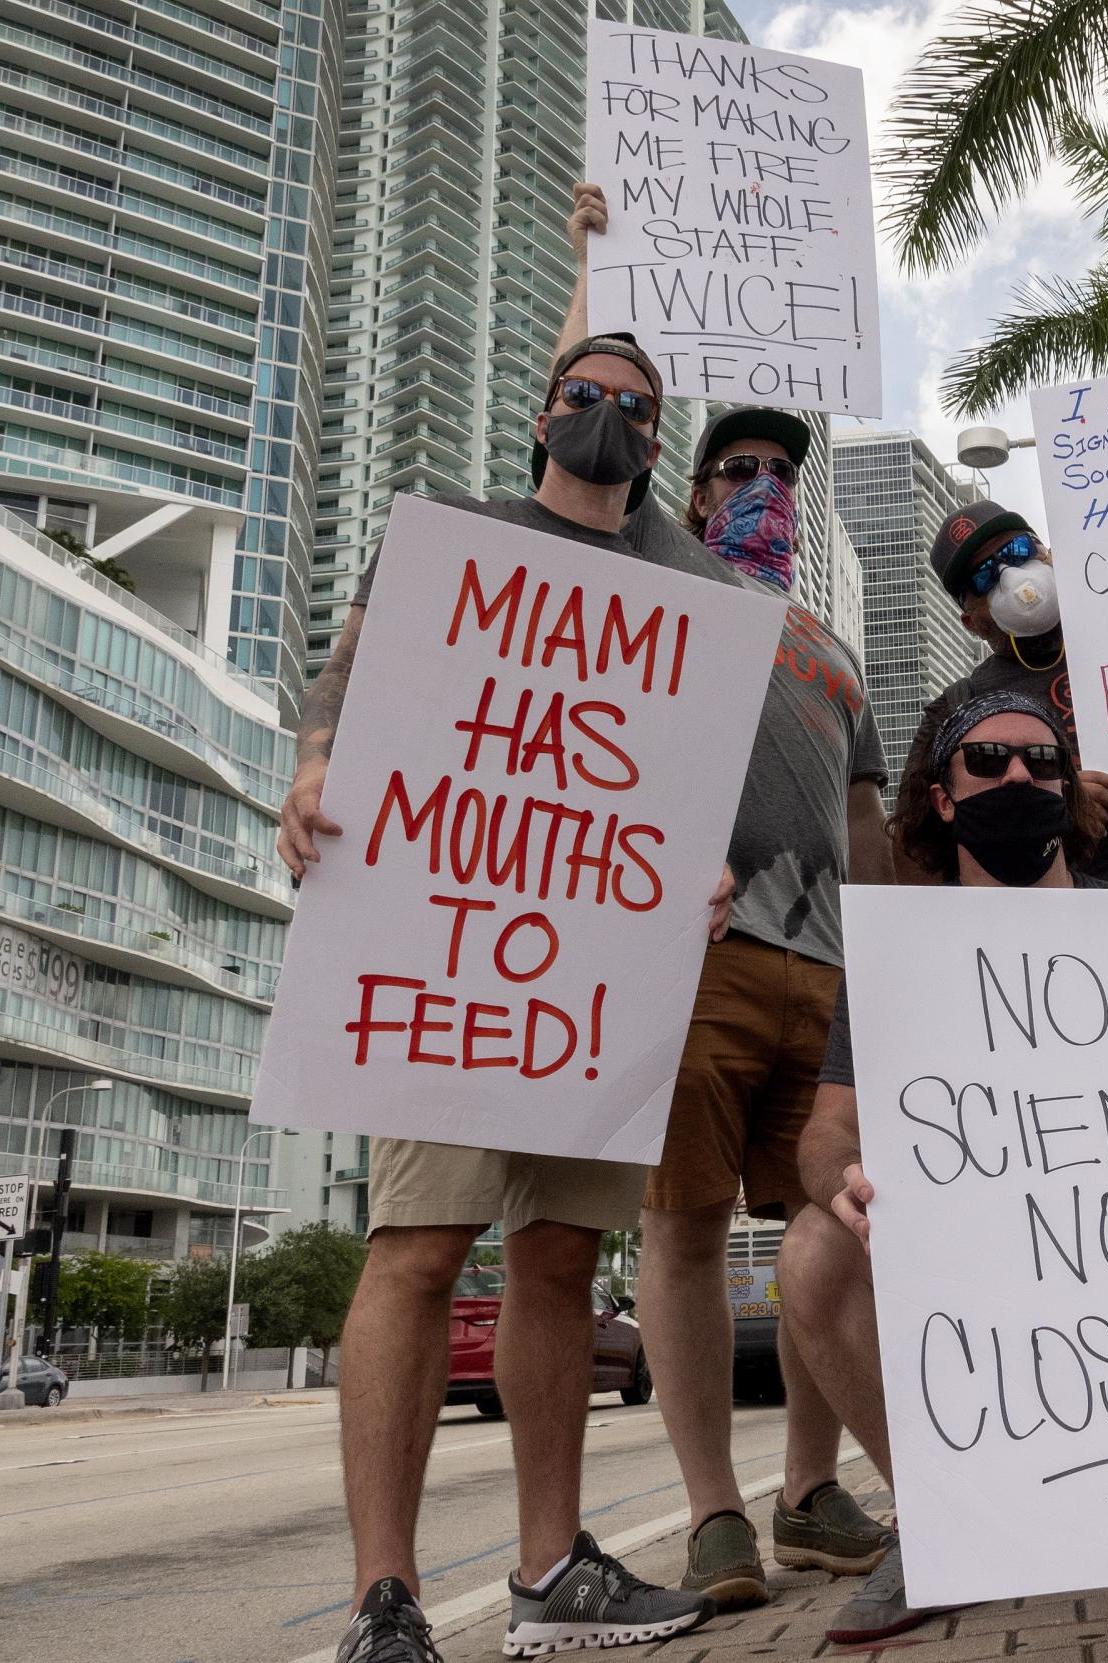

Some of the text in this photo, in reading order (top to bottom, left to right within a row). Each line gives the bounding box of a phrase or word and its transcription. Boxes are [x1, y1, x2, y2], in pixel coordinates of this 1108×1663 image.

[610, 33, 828, 103] THANKS
[602, 80, 850, 154] FOR MAKING
[615, 130, 819, 186] ME FIRE
[624, 175, 833, 233] MY WHOLE
[592, 263, 864, 349] TWICE!
[657, 352, 849, 409] TFOH!
[1059, 387, 1092, 423] I
[446, 559, 690, 697] MIAMI
[454, 676, 640, 791] HAS
[365, 770, 665, 912] MOUTHS
[429, 894, 559, 982] TO
[345, 974, 607, 1081] FEED!
[976, 947, 1108, 1052] NO
